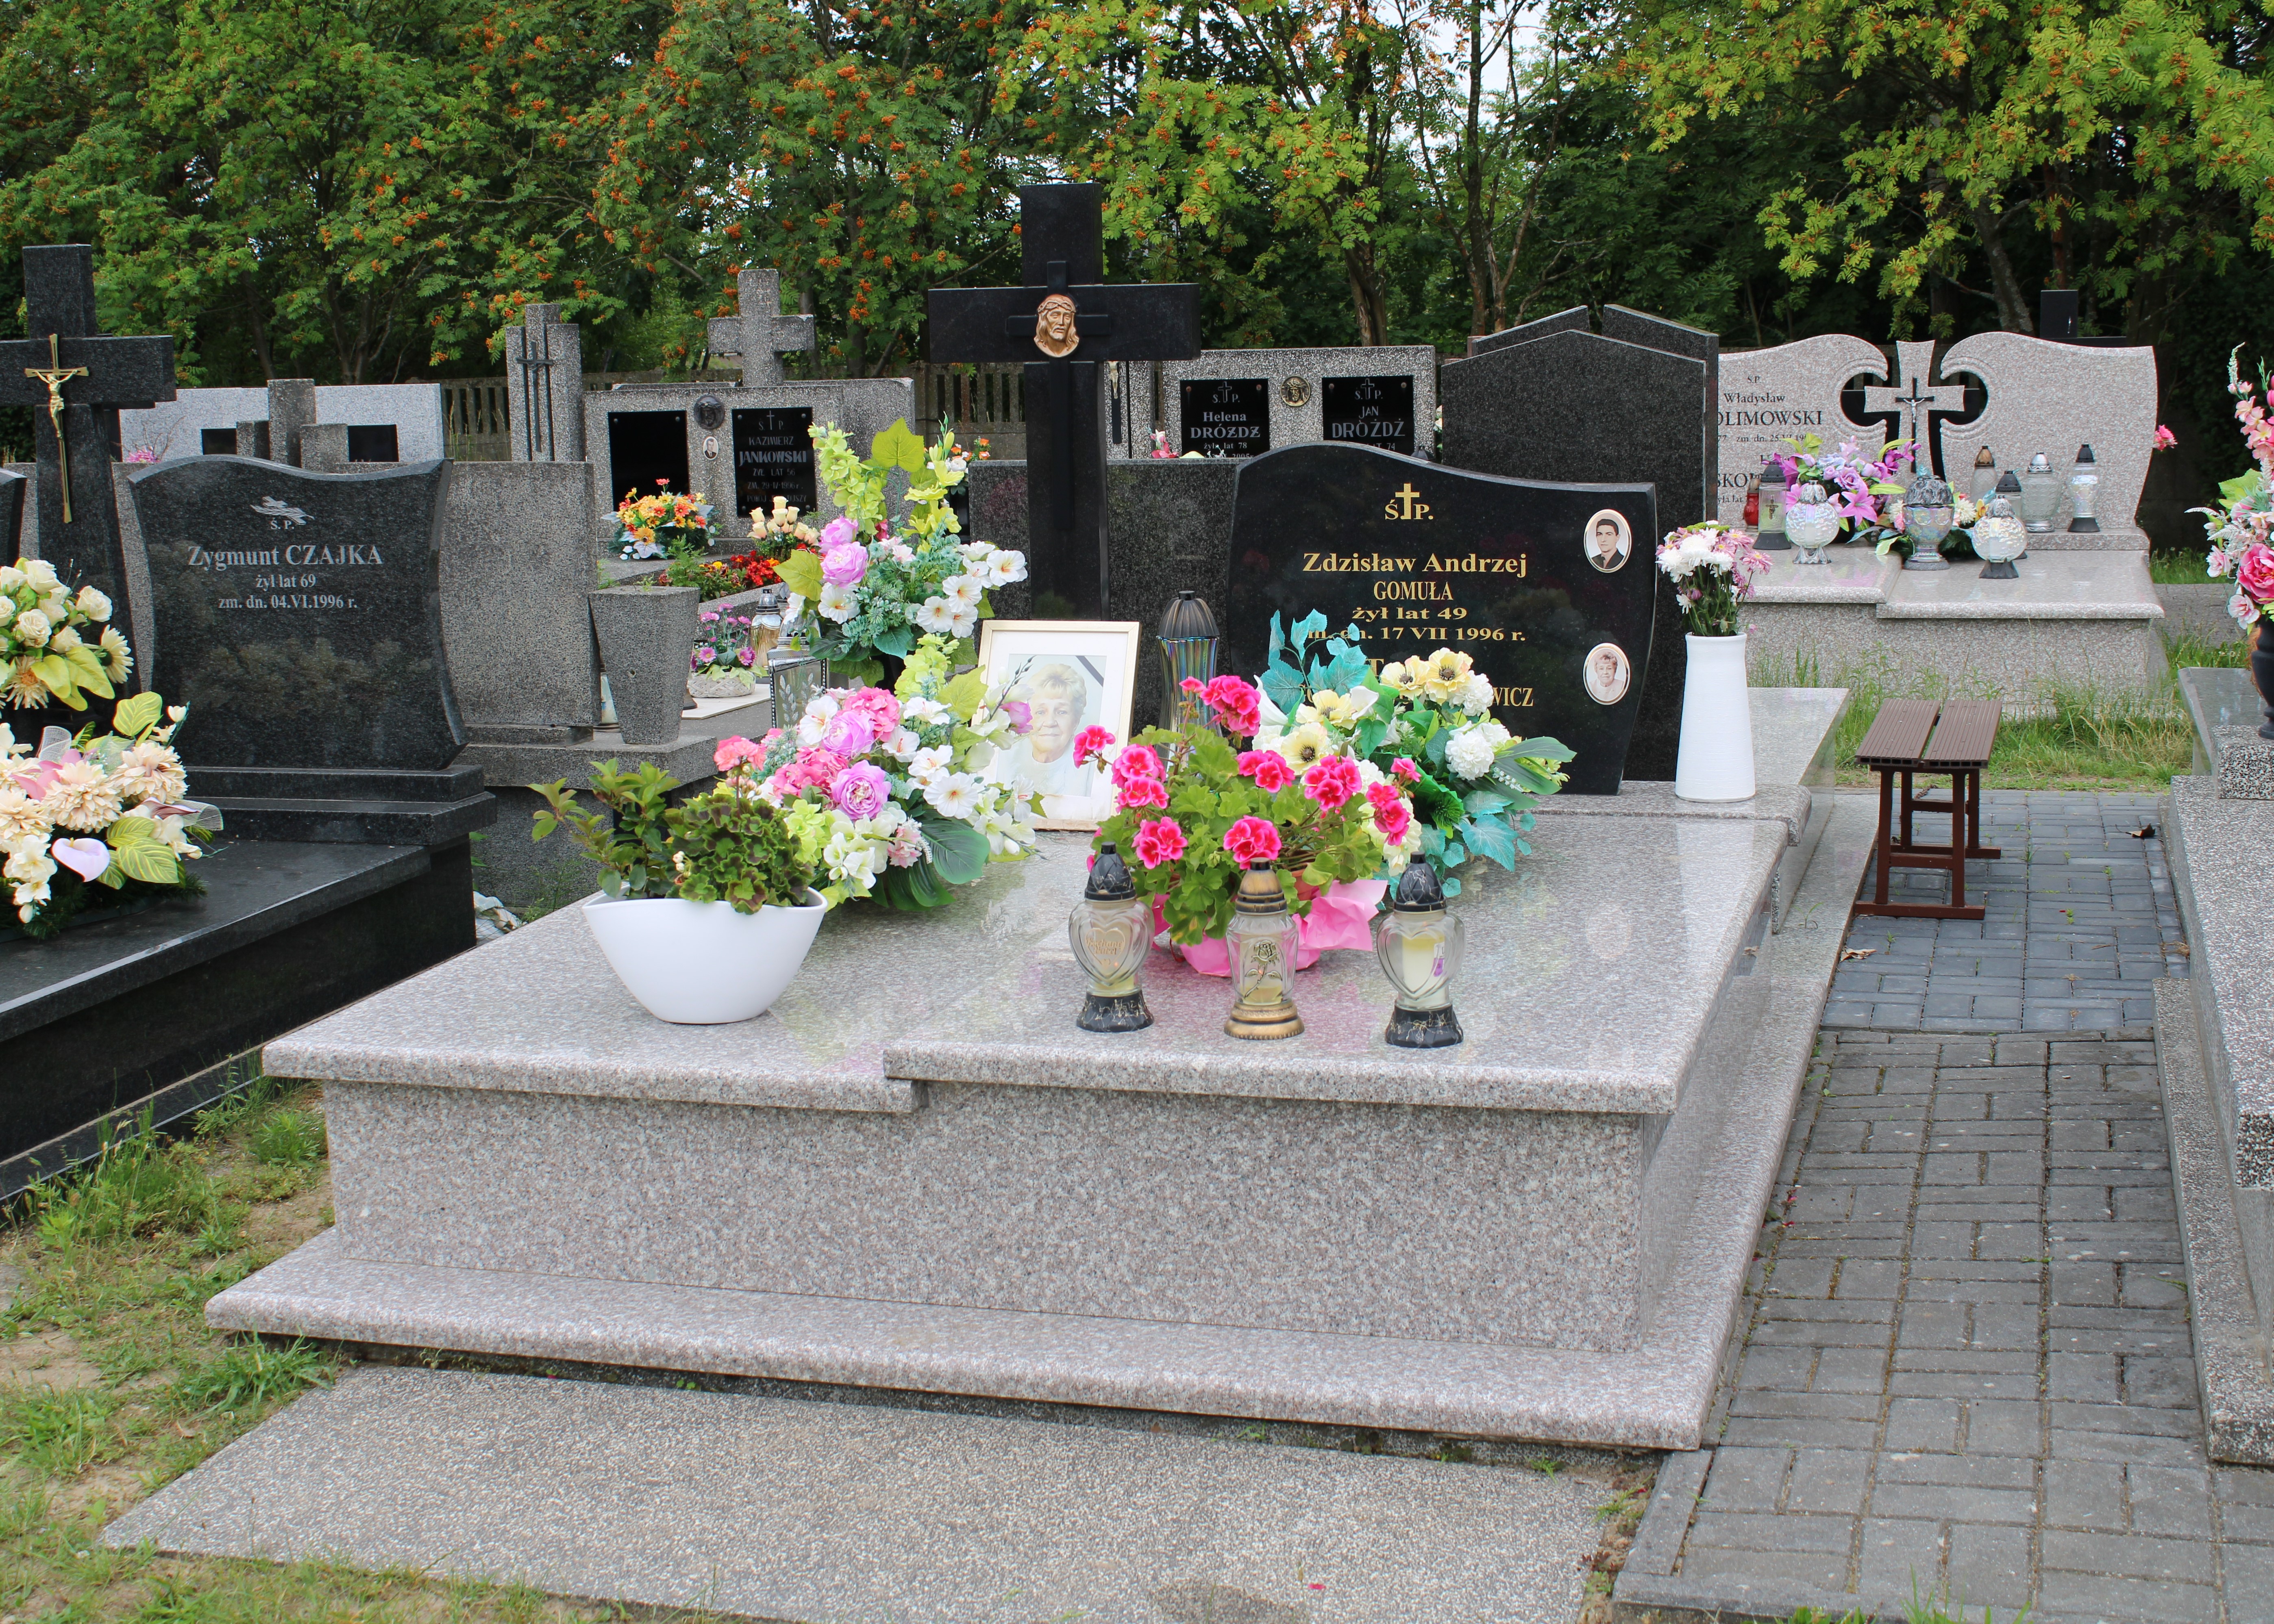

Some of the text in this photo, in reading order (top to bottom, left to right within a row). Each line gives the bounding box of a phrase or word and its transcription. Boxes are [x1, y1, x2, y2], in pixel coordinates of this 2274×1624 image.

[1232, 394, 1240, 402] P.
[1375, 390, 1383, 399] P.
[1724, 392, 1785, 405] Władysław
[1203, 412, 1247, 422] Helena
[1359, 406, 1378, 419] JAN
[749, 437, 794, 446] KAZIMIERZ
[739, 451, 807, 467] JANKOWSKI
[1413, 504, 1434, 520] P.
[284, 520, 294, 529] P.
[187, 545, 383, 570] Zygmunt CZAJKA
[1303, 553, 1526, 578] Zdzisław Andrzej
[279, 574, 296, 588] lat
[300, 574, 316, 588] 69
[1373, 580, 1453, 600] GOMUŁA
[219, 594, 357, 608] zm. dn. 04.VI.1996 r.
[1352, 607, 1467, 622] żył lat 49
[1381, 627, 1404, 640] 17
[1410, 627, 1447, 640] VII
[1456, 628, 1504, 640] 1996
[1511, 630, 1525, 641] r.
